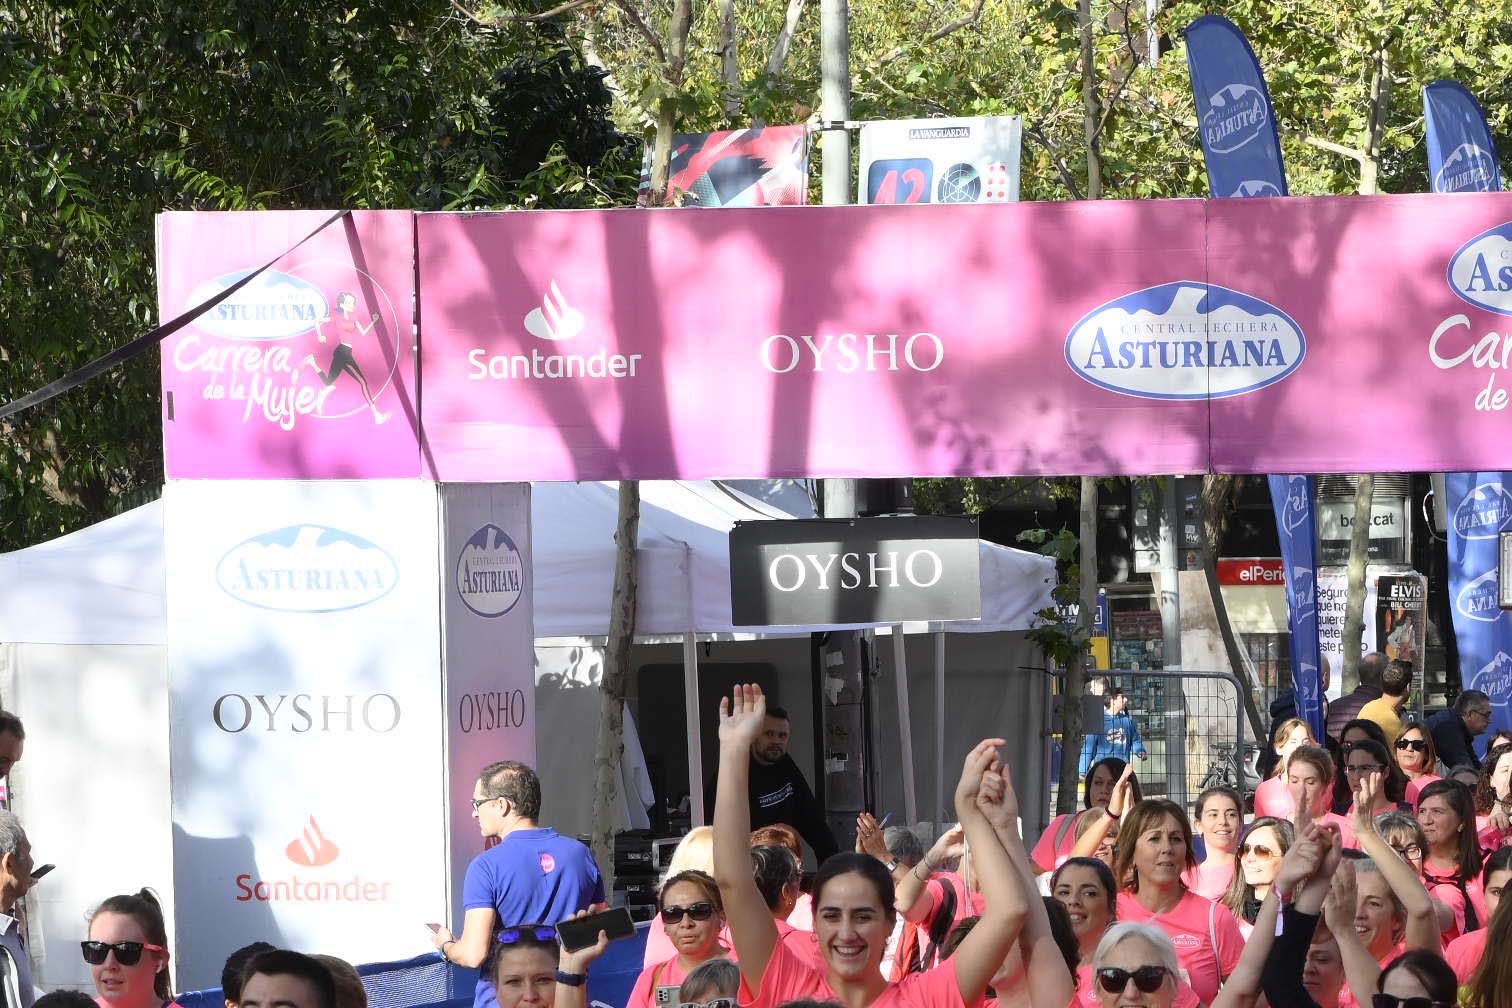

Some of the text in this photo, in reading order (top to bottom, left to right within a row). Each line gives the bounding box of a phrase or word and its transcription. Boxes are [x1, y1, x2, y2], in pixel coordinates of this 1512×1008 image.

[920, 128, 969, 138] VANGUARDIA
[1120, 321, 1280, 334] CENTRAL LECHERA
[173, 335, 292, 372] Carrera
[468, 348, 642, 380] Santander
[759, 332, 945, 374] OYSHO
[1083, 332, 1287, 371] ASTURIANA
[203, 368, 337, 431] de la Mujer
[1474, 373, 1509, 412] de
[231, 556, 386, 592] ASTURIANA
[461, 560, 520, 595] ASTURIANA
[768, 548, 943, 593] OYSHO
[1390, 585, 1421, 598] ELVIS
[212, 693, 401, 734] OYSHO
[458, 688, 526, 734] OYSHO
[235, 874, 391, 902] Santander
